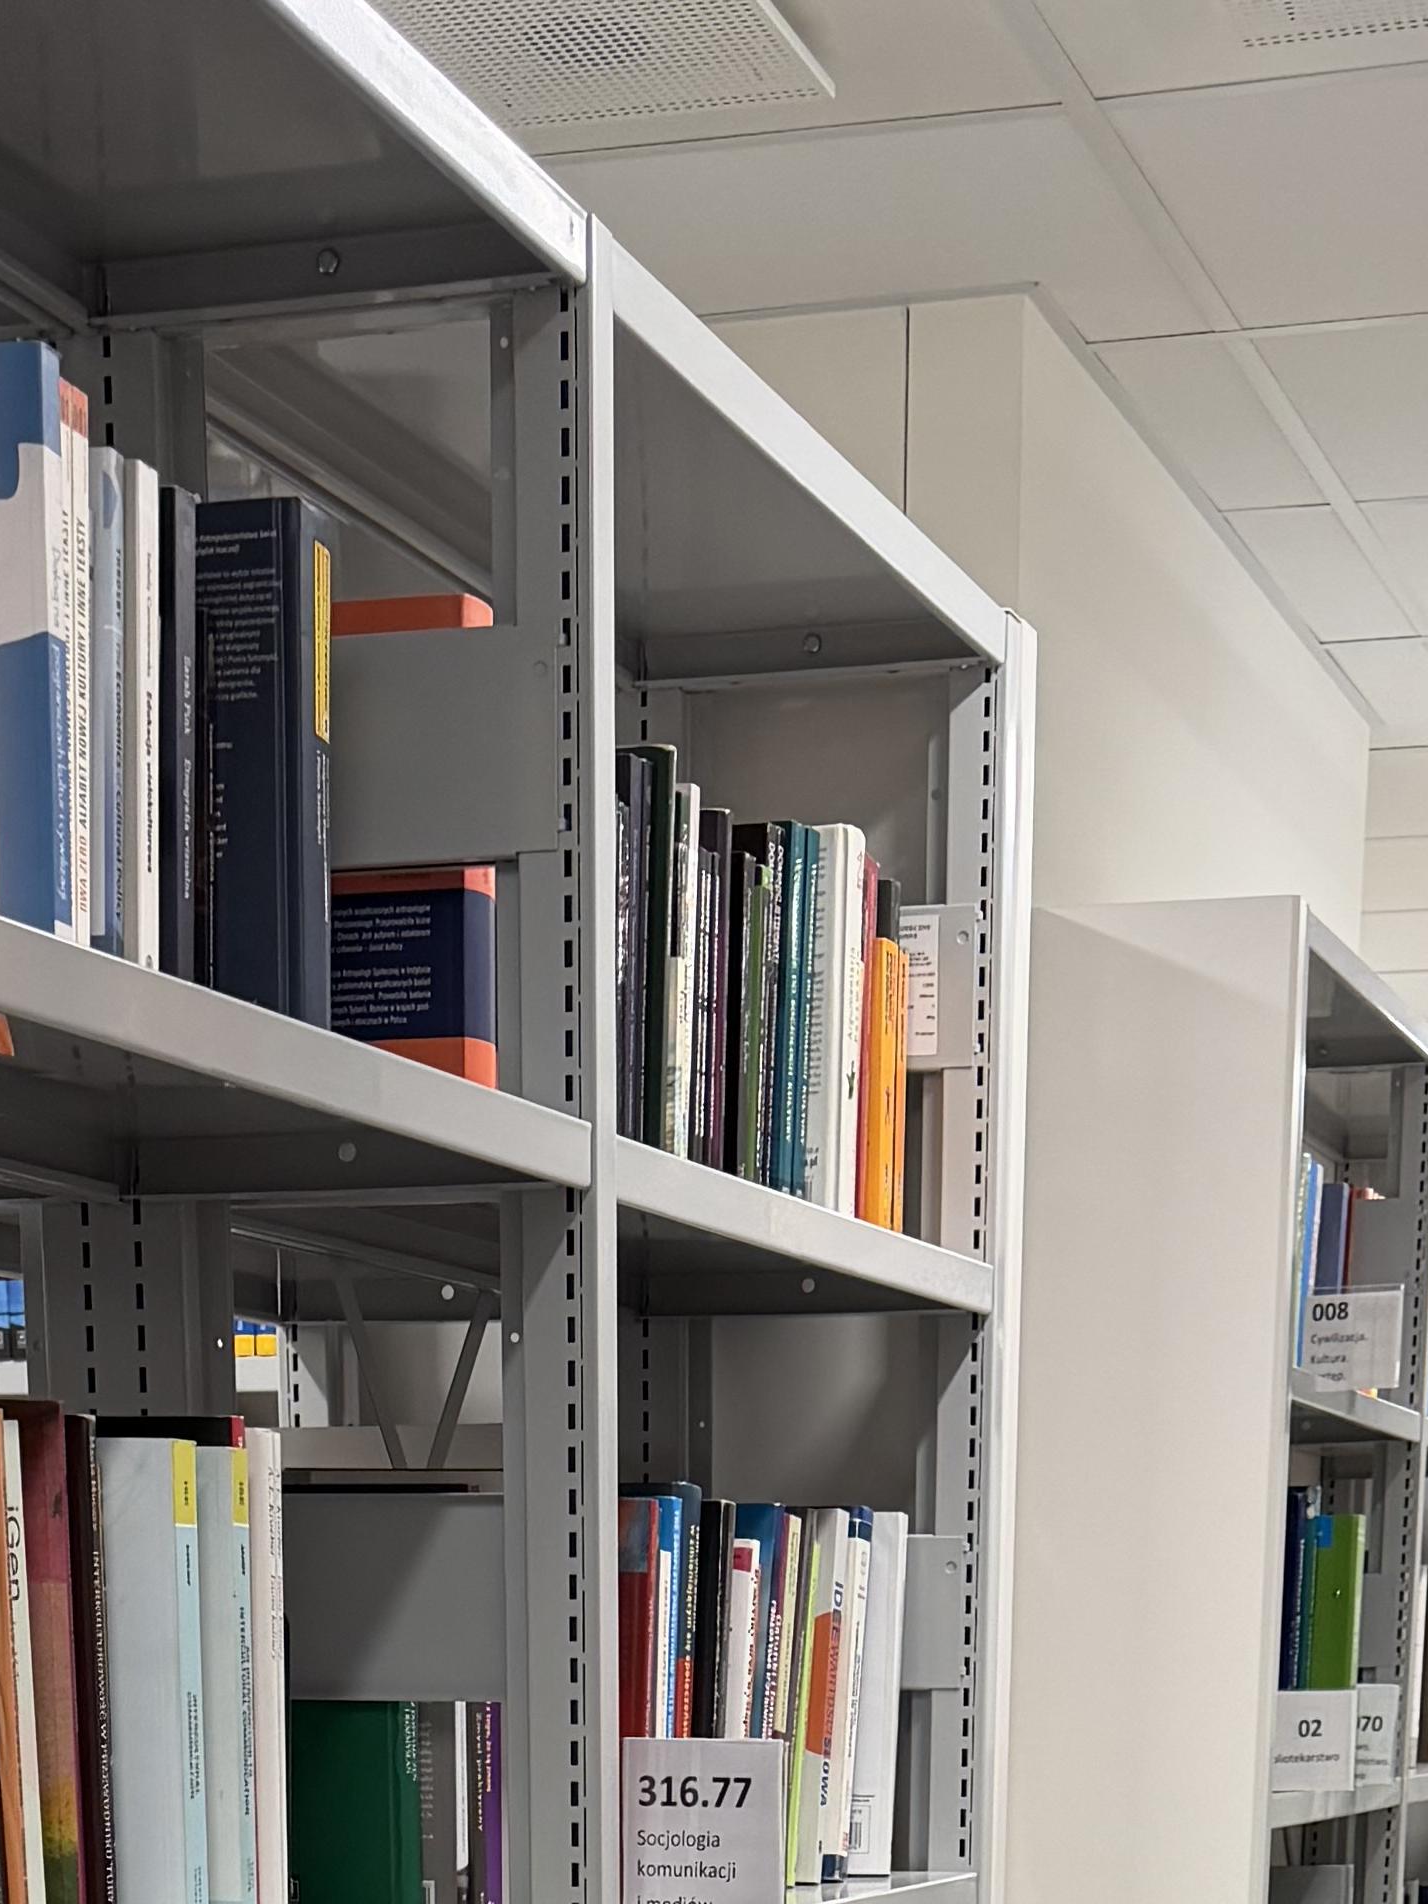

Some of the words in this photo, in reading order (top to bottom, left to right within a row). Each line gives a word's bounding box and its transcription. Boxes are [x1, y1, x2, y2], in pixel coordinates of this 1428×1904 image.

[1311, 1302, 1349, 1322] 008
[7, 1506, 21, 1601] iGen
[1297, 1719, 1323, 1738] 02
[1274, 1753, 1340, 1764] liotekarstwo
[637, 1775, 753, 1808] 316.77
[636, 1829, 721, 1851] Socjologia
[637, 1860, 737, 1881] komunikacji
